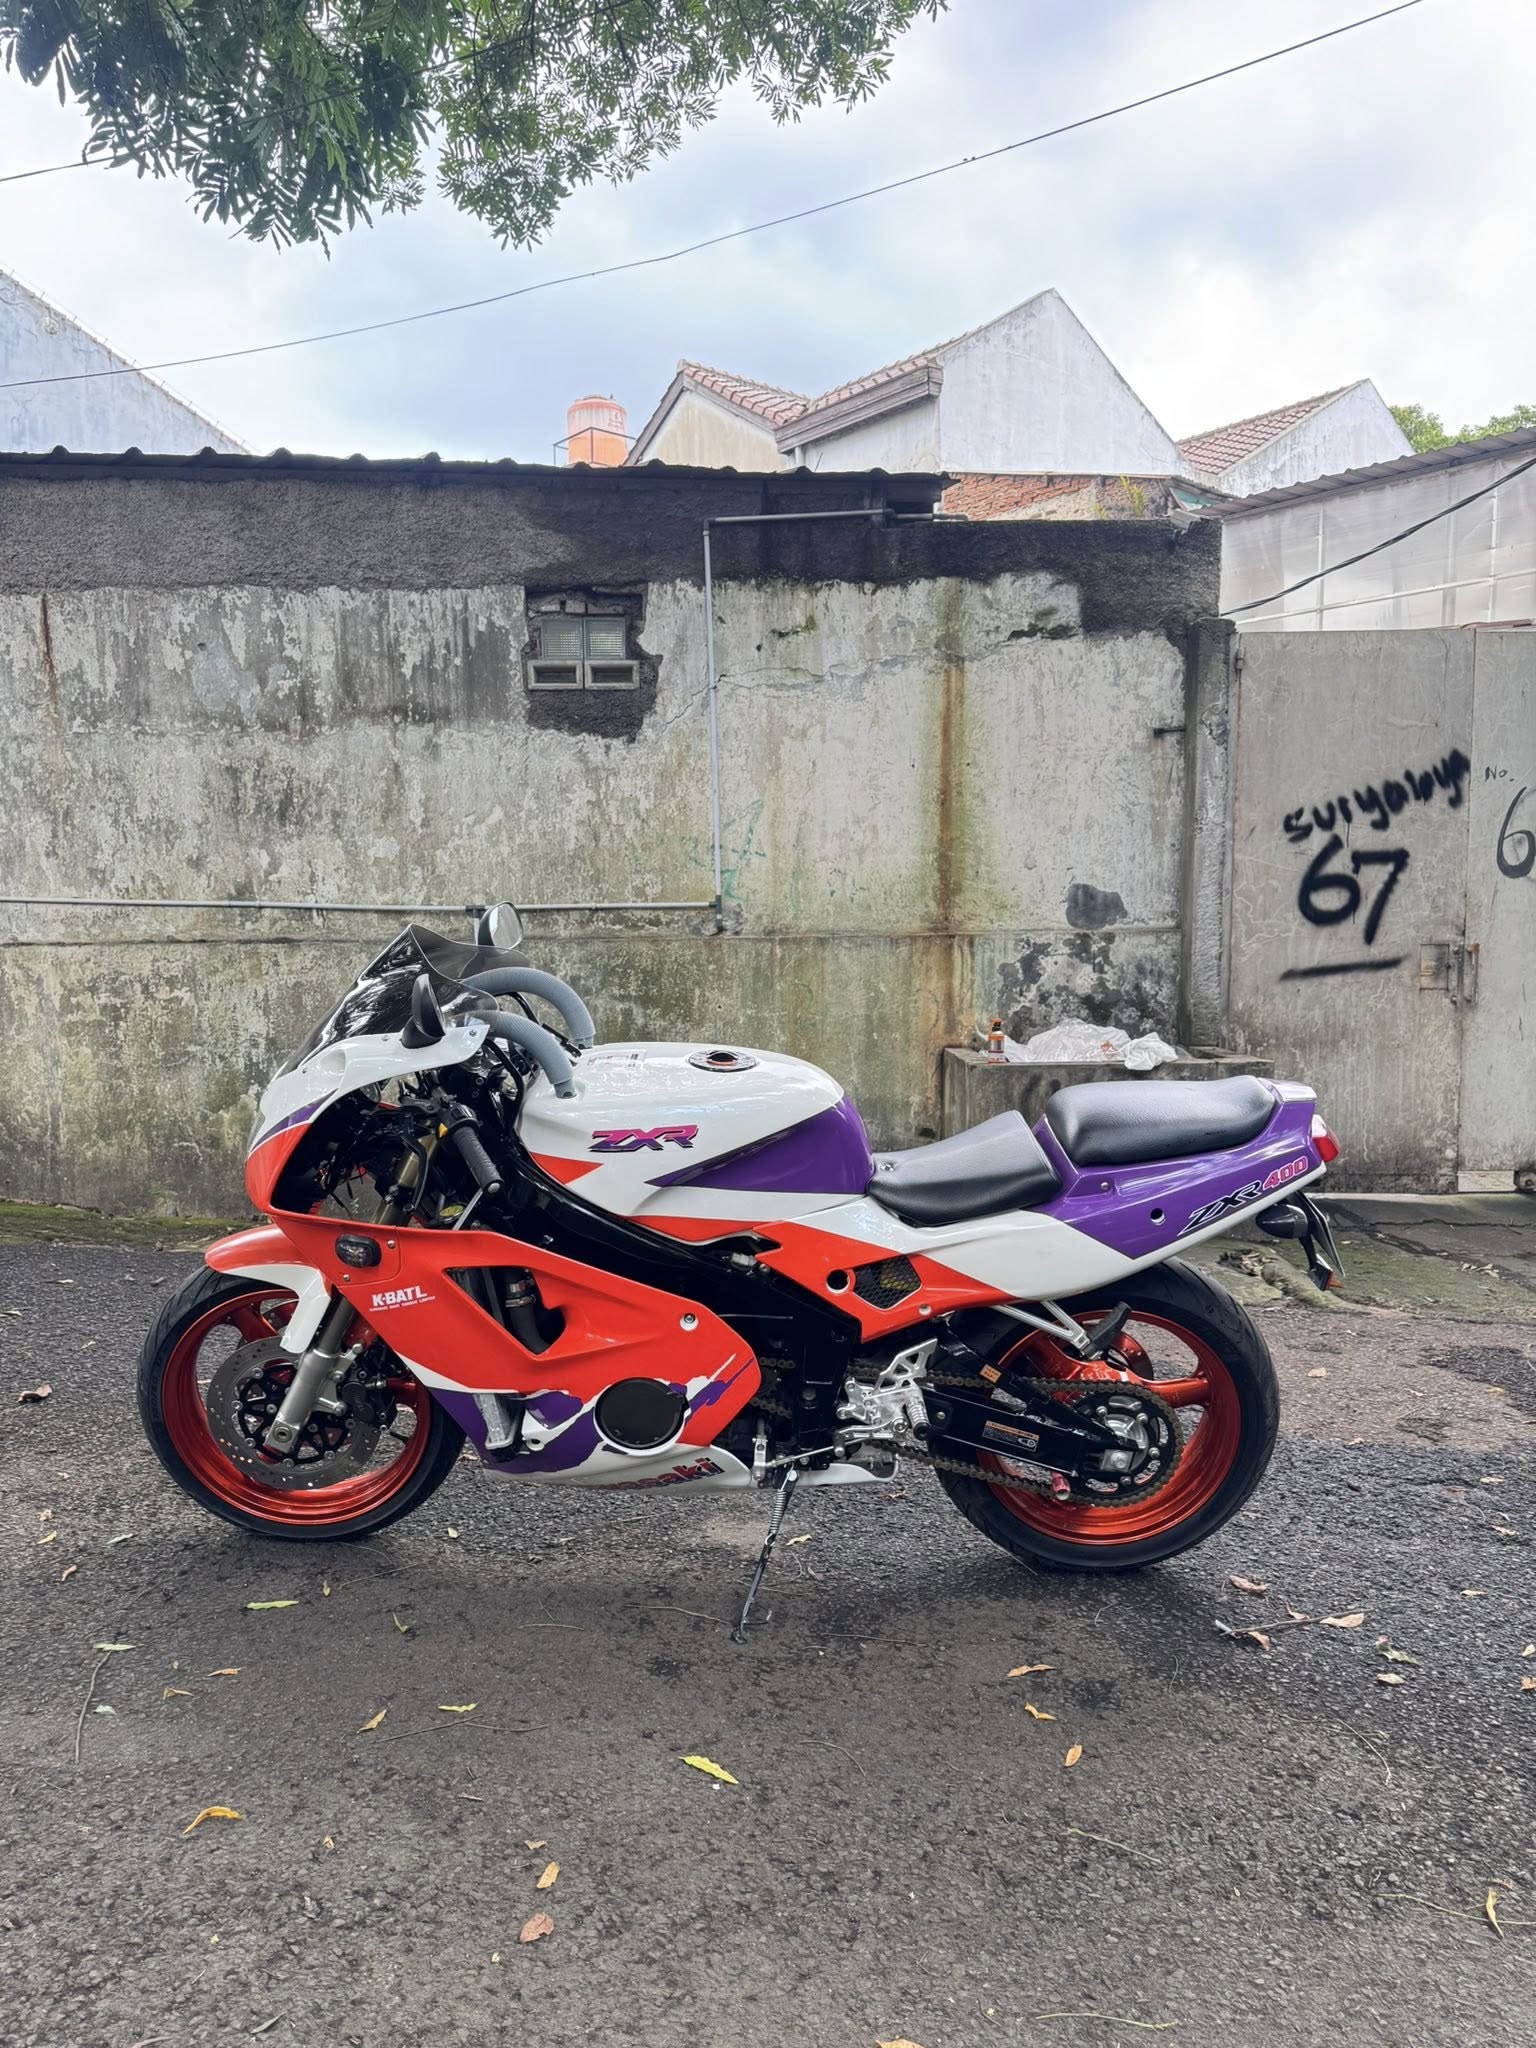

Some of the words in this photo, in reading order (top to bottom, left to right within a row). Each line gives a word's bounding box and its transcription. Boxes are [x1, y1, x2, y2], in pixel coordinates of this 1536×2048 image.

[1298, 834, 1409, 945] 67
[588, 1125, 699, 1153] ZXR
[1177, 1180, 1262, 1237] ZXR
[1262, 1156, 1308, 1191] 400
